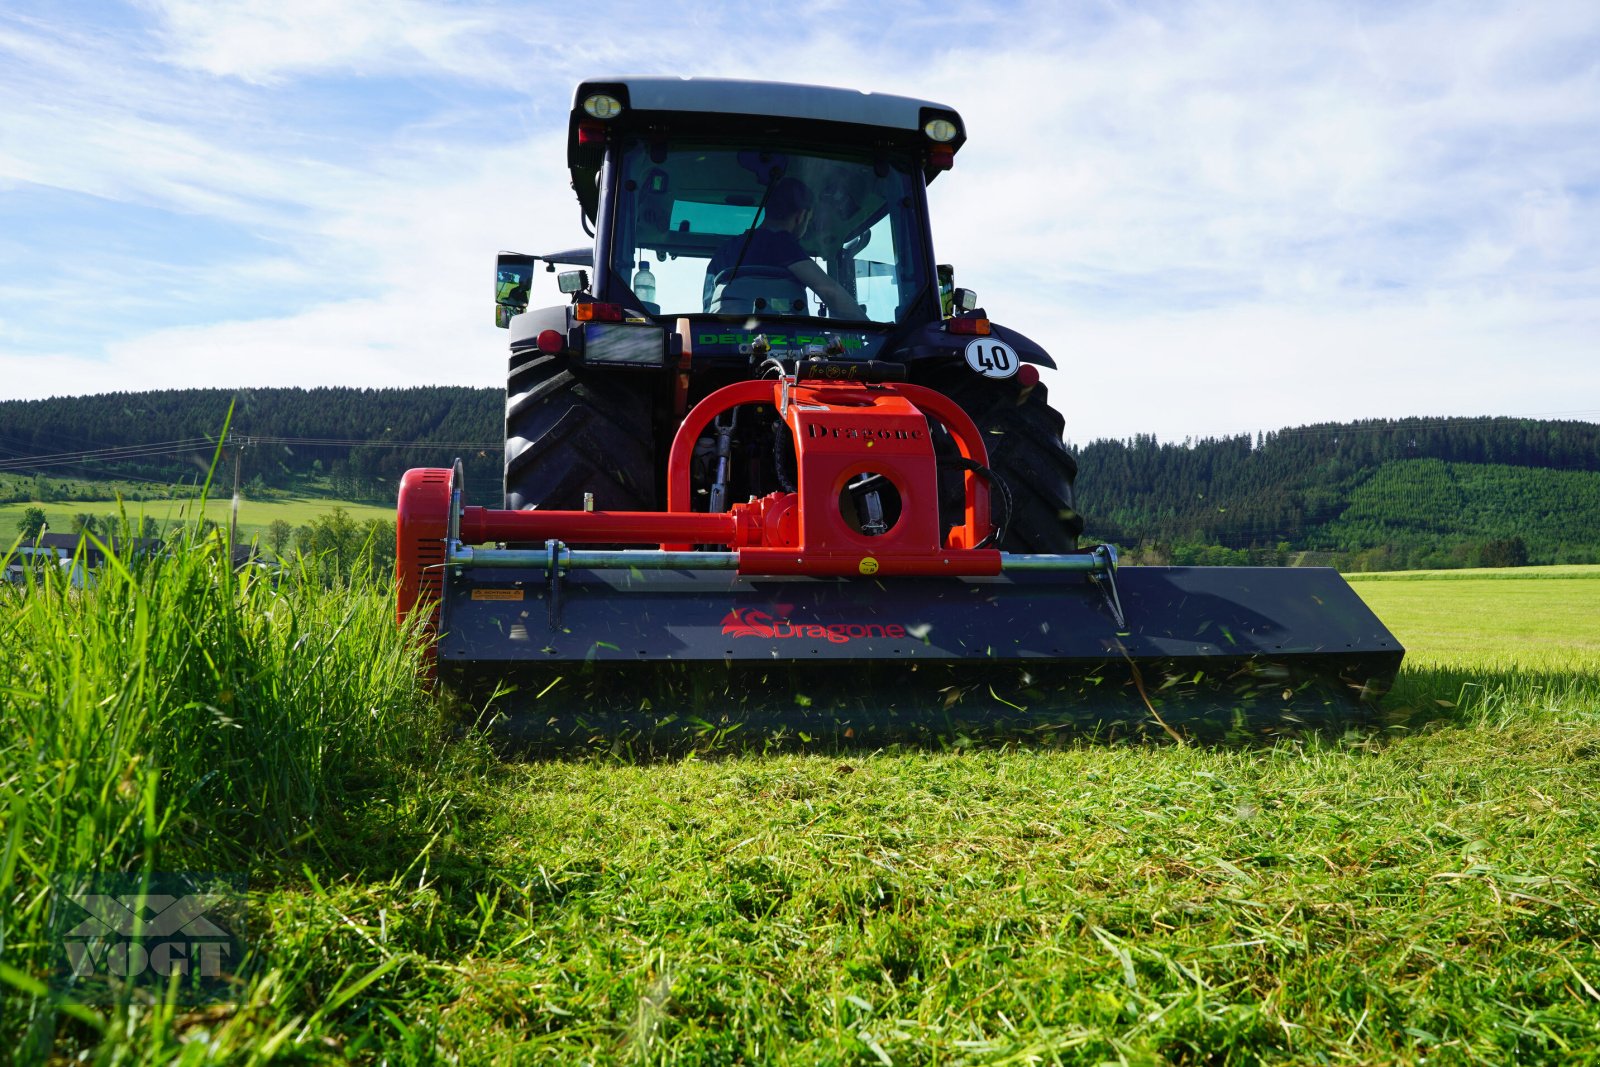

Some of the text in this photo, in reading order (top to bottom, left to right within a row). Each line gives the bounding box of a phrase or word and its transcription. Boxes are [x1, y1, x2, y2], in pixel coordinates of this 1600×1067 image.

[977, 345, 1010, 371] 40
[808, 423, 923, 442] Dragone
[773, 621, 906, 644] Dragone
